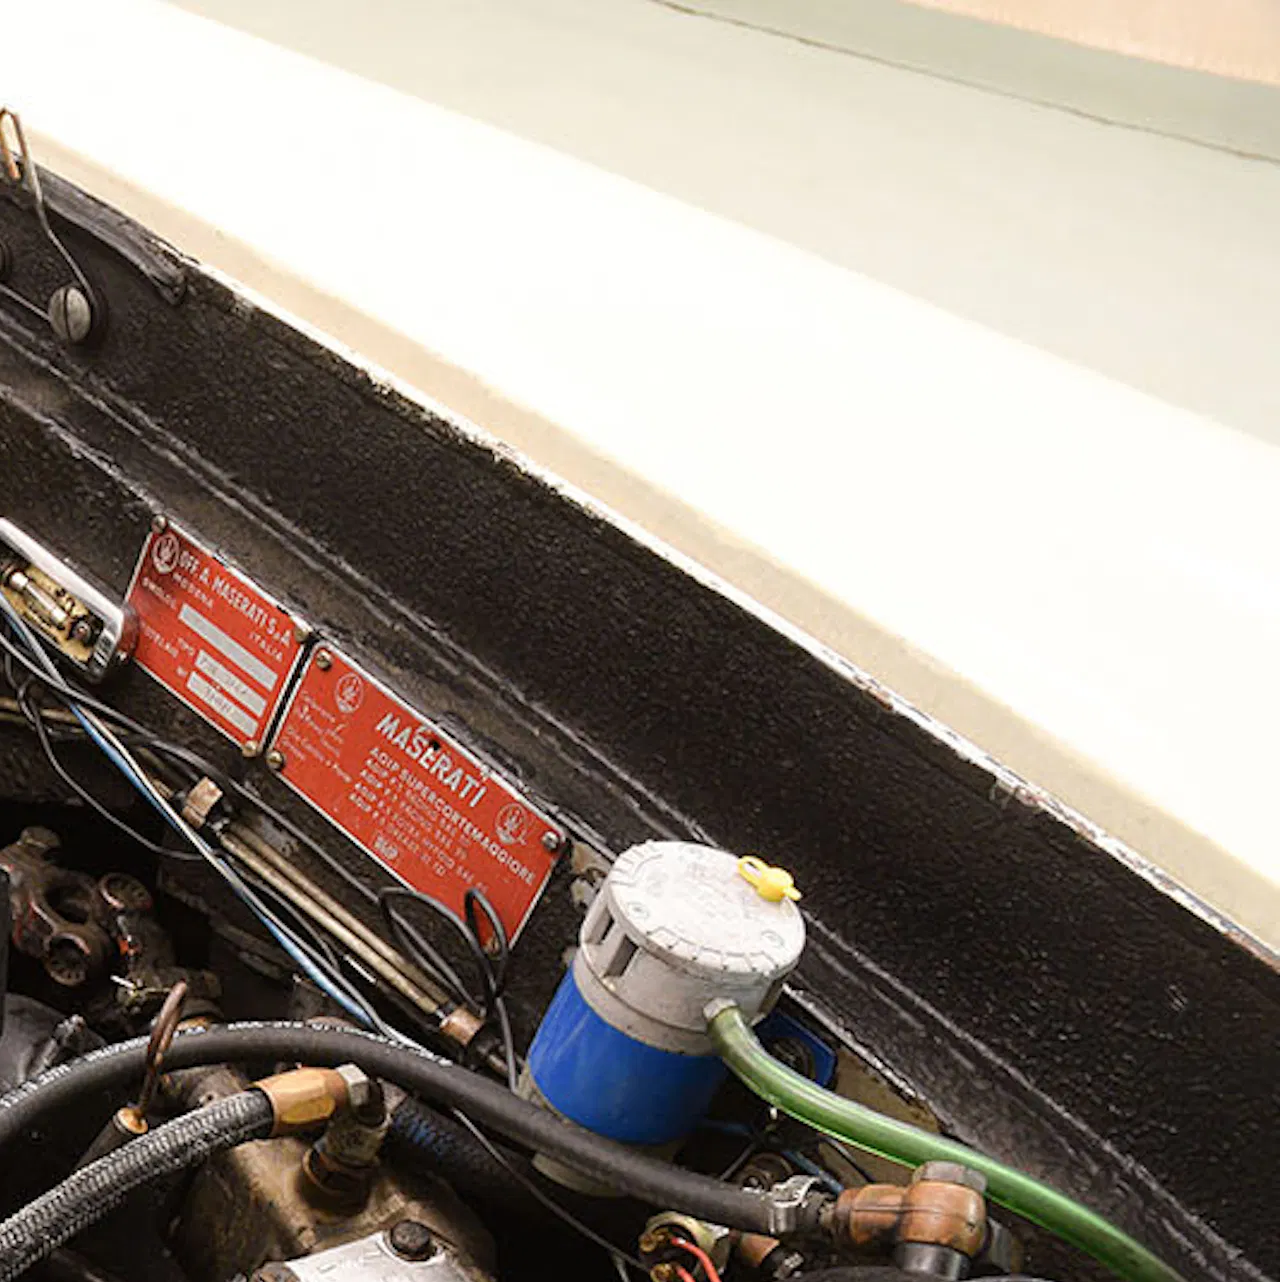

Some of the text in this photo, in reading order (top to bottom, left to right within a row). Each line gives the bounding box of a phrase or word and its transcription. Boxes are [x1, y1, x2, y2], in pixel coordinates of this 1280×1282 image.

[210, 573, 269, 629] MASERATI
[247, 629, 285, 664] ITALIA
[375, 711, 488, 809] MASERATI
[396, 768, 537, 887] SUPERCORTEMAGGIORE
